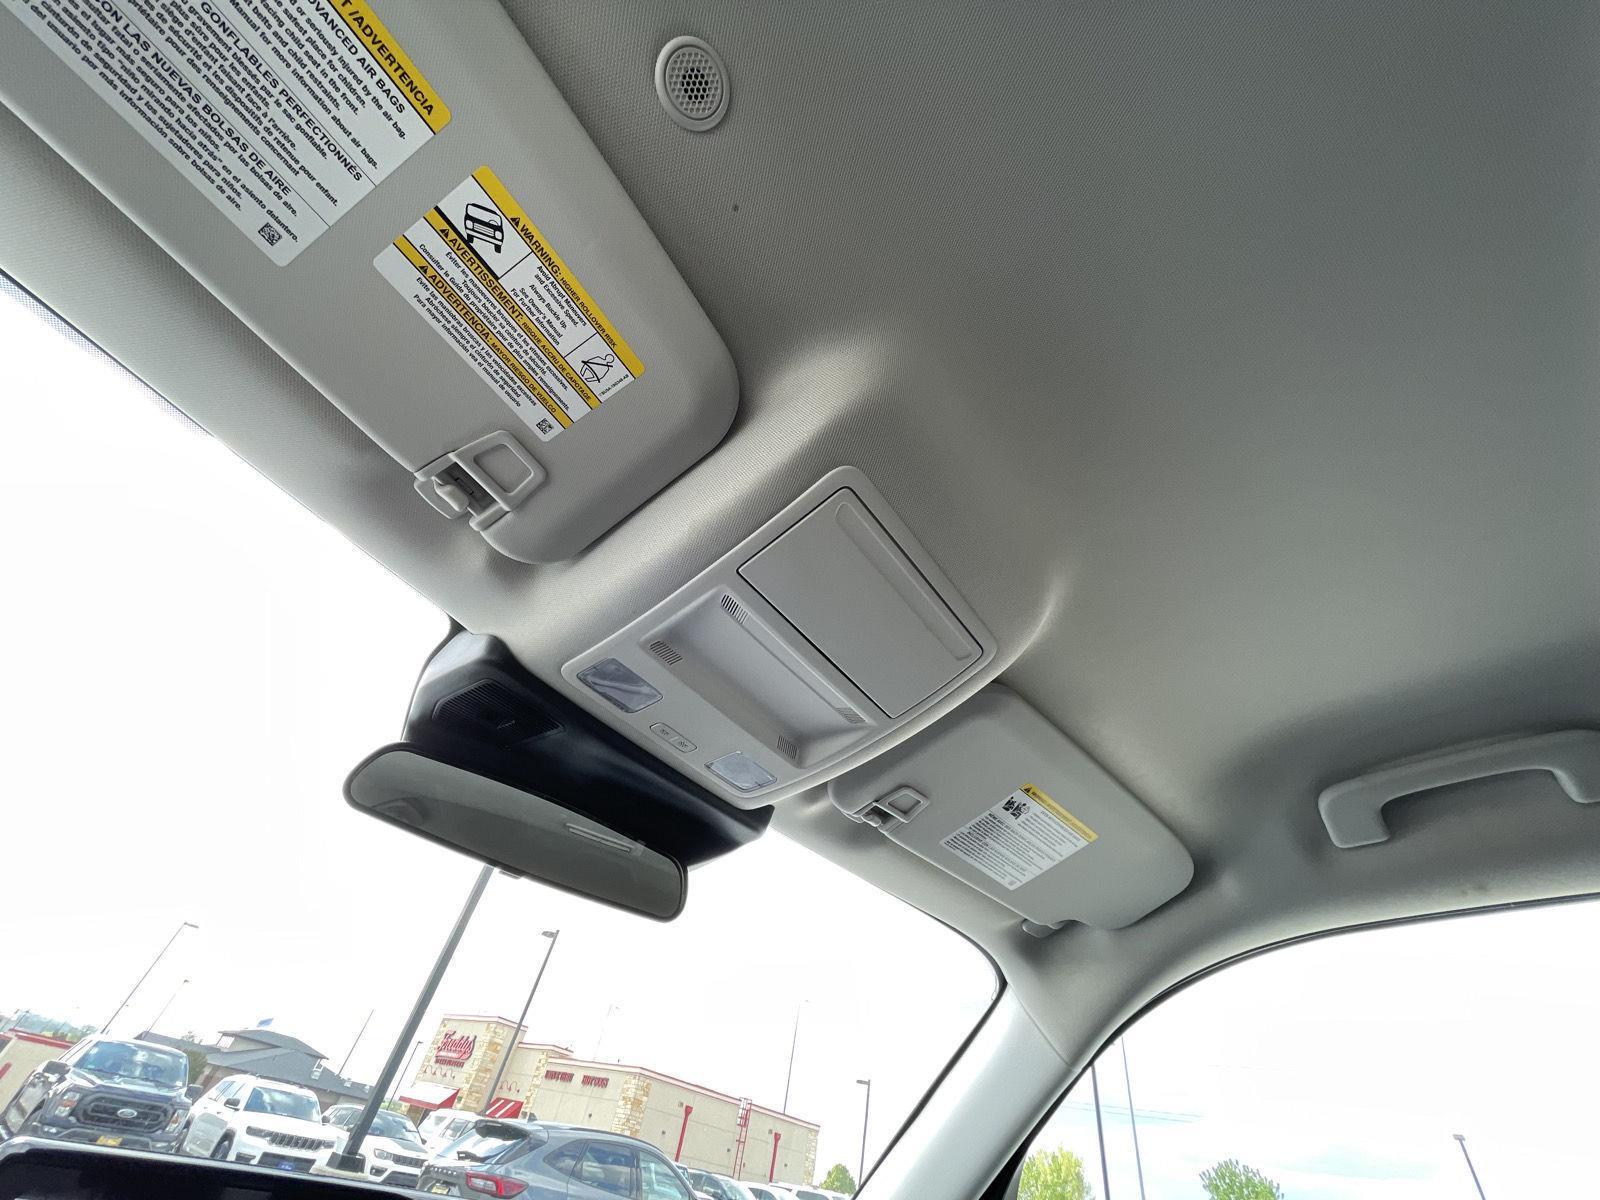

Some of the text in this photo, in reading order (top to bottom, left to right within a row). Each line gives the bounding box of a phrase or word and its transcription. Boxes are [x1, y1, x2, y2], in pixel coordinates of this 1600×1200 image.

[30, 4, 47, 20] del
[46, 20, 82, 55] usuario
[167, 138, 191, 160] sobre
[190, 159, 216, 185] bolsas
[225, 194, 241, 211] aire.
[90, 19, 116, 45] lugar
[135, 65, 165, 95] seguro
[164, 95, 185, 115] para
[93, 52, 138, 95] seguridad
[157, 115, 203, 160] sujetadores
[202, 159, 221, 177] para
[95, 0, 292, 196] ON LAS NUEVAS BOLSAS DE AIRE
[164, 35, 187, 57] pour
[186, 57, 202, 74] des
[202, 74, 261, 136] renseignements
[260, 135, 300, 176] concernant
[187, 5, 232, 53] gravement
[259, 84, 275, 99] par
[281, 108, 296, 123] sac
[294, 123, 327, 160] gonflable.
[200, 1, 362, 181] GONFLABLES PERFECTIONNÉS
[208, 42, 229, 62] pour
[241, 76, 270, 110] enfants.
[218, 64, 246, 94] faisant
[244, 93, 262, 112] face
[252, 5, 340, 111] belts and child restraints.
[259, 31, 272, 45] for
[271, 46, 292, 69] more
[291, 67, 332, 115] information
[330, 114, 352, 138] about
[350, 137, 362, 148] air
[360, 147, 378, 169] bags.
[282, 8, 366, 108] safest place for children.
[284, 28, 305, 50] child
[303, 50, 321, 70] seat
[328, 78, 341, 93] the
[340, 92, 358, 116] front.
[305, 17, 406, 140] seriously injured the air bag.
[348, 10, 434, 116] /ADVERTENCIA
[356, 57, 377, 79] AIR
[375, 78, 405, 113] BAGS
[61, 6, 96, 41] asiento
[96, 40, 115, 59] tipo
[140, 84, 175, 118] mirando
[174, 117, 197, 141] hacia
[240, 183, 266, 209] asiento
[266, 209, 298, 243] delantero.
[111, 25, 133, 48] fatal
[140, 55, 186, 103] seriamente
[186, 102, 224, 141] afectados
[249, 166, 273, 191] bolsas
[282, 200, 297, 217] aire.
[224, 85, 263, 126] dispositifs
[273, 136, 300, 165] retenue
[298, 164, 317, 181] pour
[315, 182, 338, 207] enfant.
[427, 274, 556, 413] ADVERTENCIA: MAYOR RIESGO DE VUELCO
[448, 238, 592, 402] AVERTISSEMENT: RISQUE ACCRU DE CAPOTAGE
[520, 224, 562, 277] WARNING:
[559, 276, 580, 302] HIGHER
[578, 301, 606, 334] ROLLOVER
[604, 333, 617, 348] RISK
